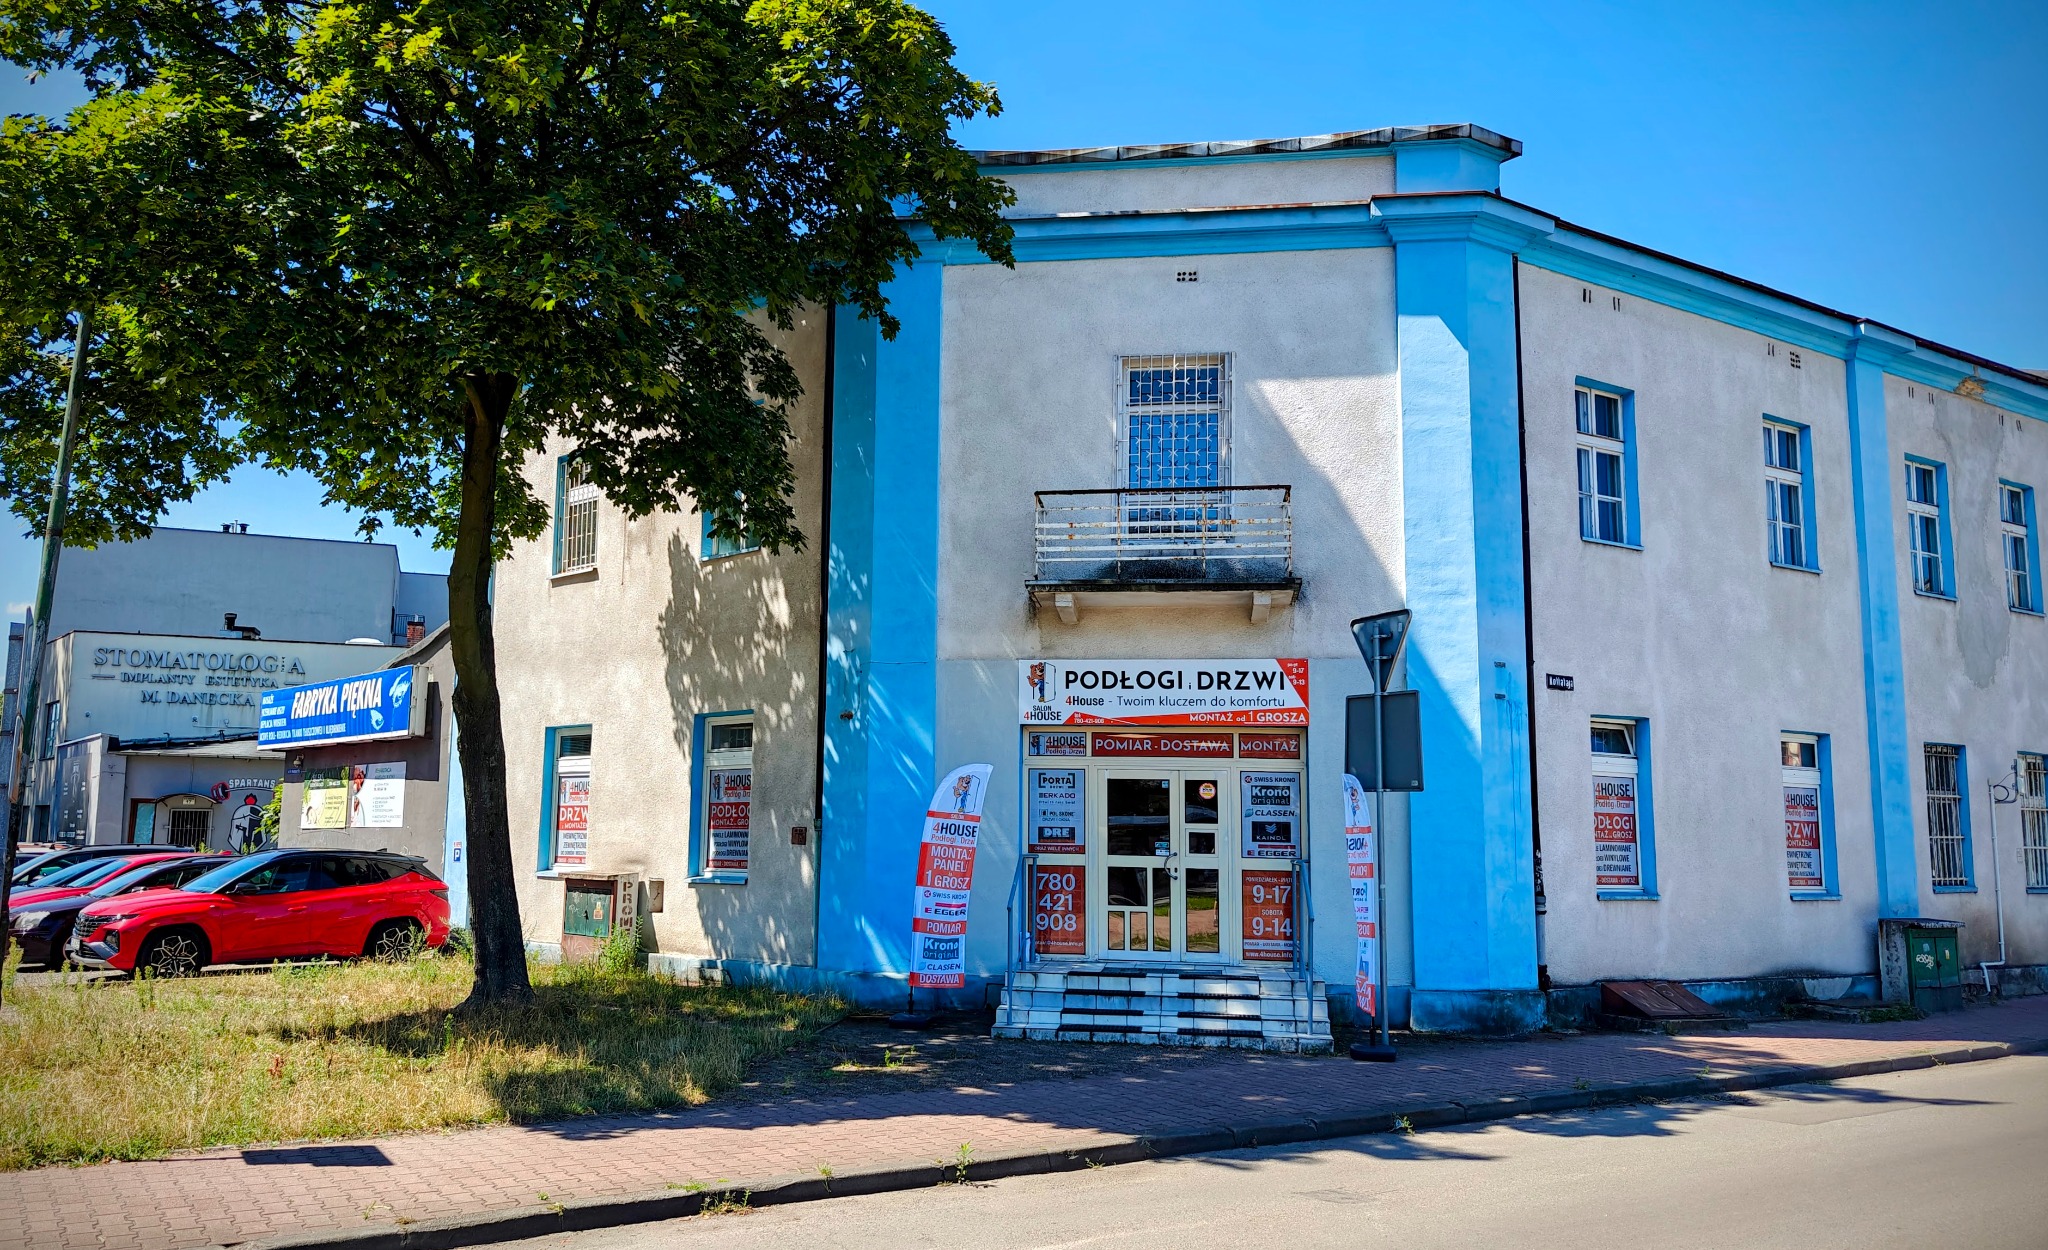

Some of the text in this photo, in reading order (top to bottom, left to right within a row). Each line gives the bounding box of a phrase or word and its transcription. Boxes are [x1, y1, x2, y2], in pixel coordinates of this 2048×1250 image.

[121, 672, 278, 688] IMPLANTY ESTETYKA
[1065, 670, 1285, 690] PODŁOGI i DRZWI
[142, 690, 256, 707] M. DANECKA
[291, 677, 382, 720] FABRYKA PIĘKNA
[1066, 696, 1285, 706] 4House Twoim kluczem do komfortu
[1024, 711, 1062, 720] 4HOUSE
[1190, 712, 1233, 722] MONTAŻ
[1249, 712, 1254, 722] 1
[1257, 712, 1306, 722] GROSZA
[1046, 736, 1085, 746] 4HOUSE
[1096, 738, 1230, 752] POMIAR DOSTAWA
[1240, 740, 1298, 752] MONTAŻ
[229, 778, 276, 789] SPARTANS
[1595, 782, 1630, 796] 4HOUSE
[1252, 786, 1290, 796] Krono
[1785, 793, 1814, 806] 4HOUSE
[932, 822, 978, 838] 4HOUSE
[1043, 828, 1070, 837] DRE
[1786, 822, 1815, 838] RZWI
[931, 834, 957, 844] Podłogi
[1600, 844, 1632, 852] LAMINOWANE
[1604, 854, 1629, 862] WINYLOWE
[1603, 864, 1632, 872] DREWNIANE
[926, 870, 970, 889] 1 GROSZ
[1037, 873, 1075, 891] 780
[1252, 884, 1291, 904] 9-17
[1039, 893, 1072, 911] 421
[927, 922, 961, 933] POMIAR
[1036, 913, 1076, 931] 908
[1252, 916, 1292, 936] 9-14
[924, 938, 959, 950] Krono
[920, 974, 959, 984] DOSTAWA
